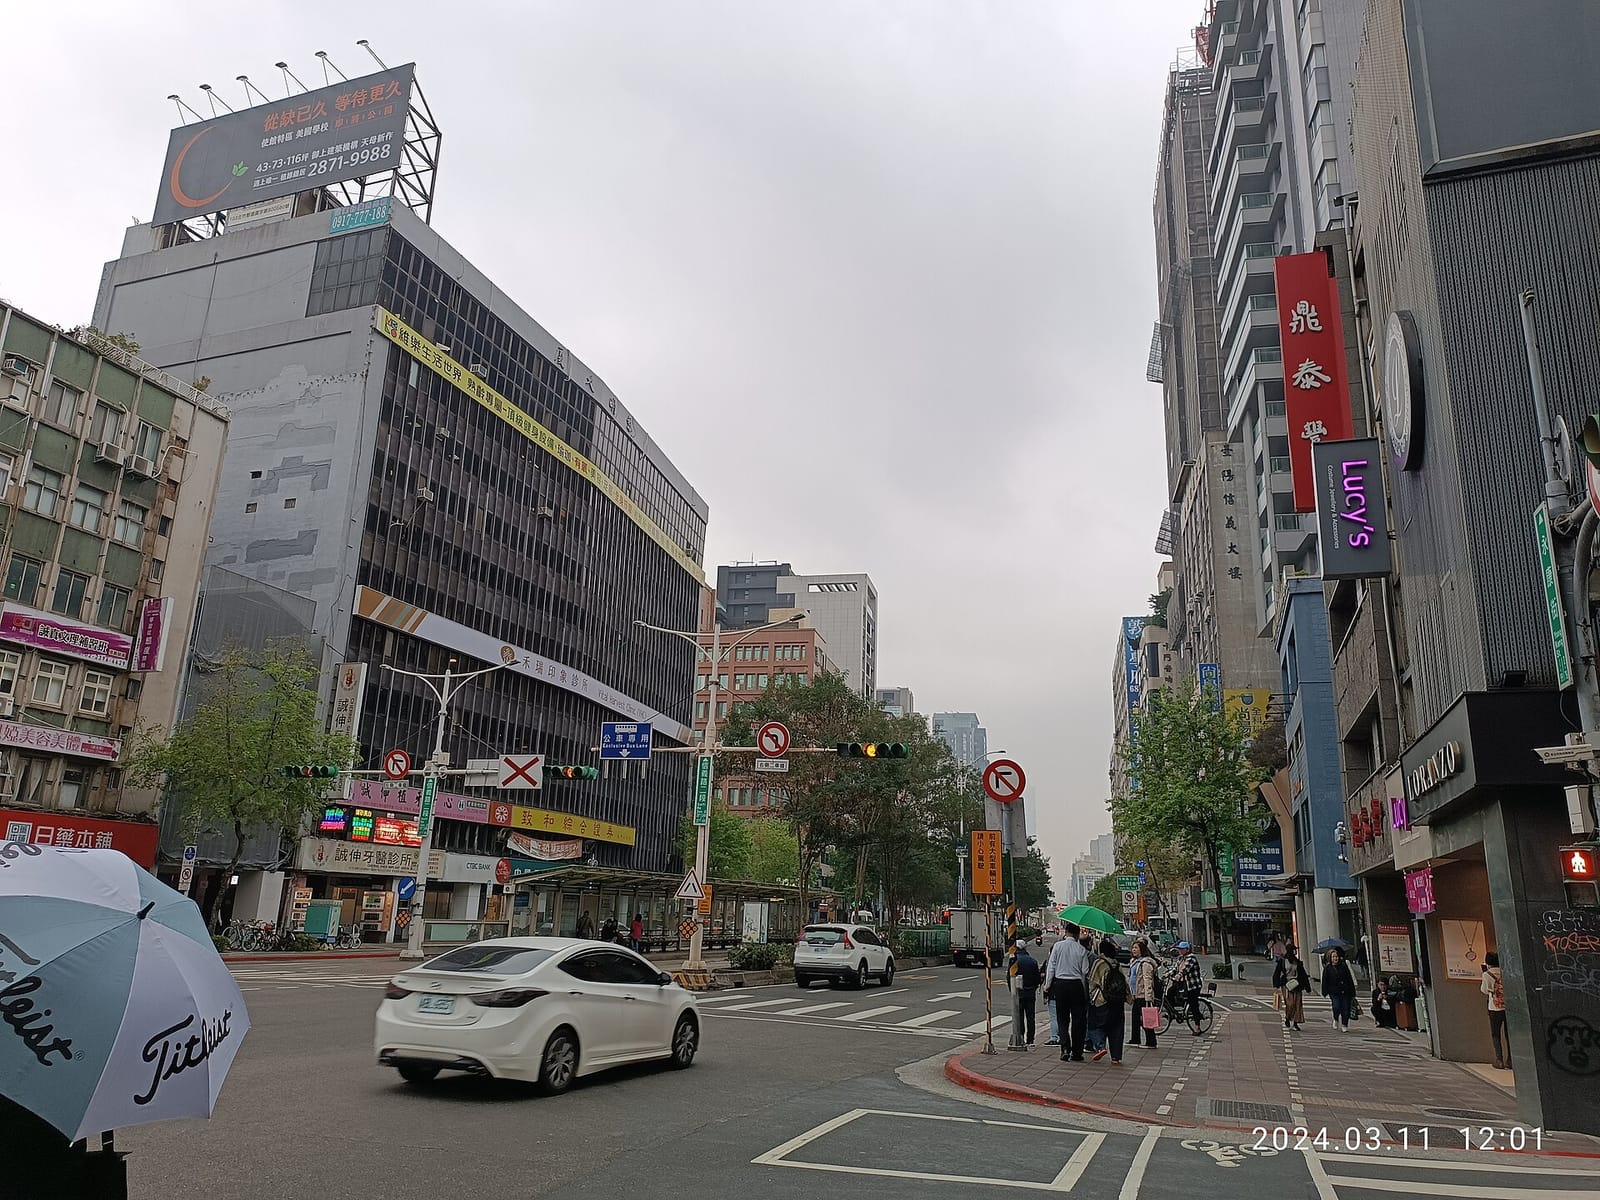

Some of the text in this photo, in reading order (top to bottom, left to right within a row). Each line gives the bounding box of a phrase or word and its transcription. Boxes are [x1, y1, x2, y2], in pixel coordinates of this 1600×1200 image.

[264, 80, 402, 132] 從缺已久 等待更久
[296, 122, 329, 138] 美國學校
[361, 132, 394, 148] 天母新作
[308, 144, 391, 177] 2871-9988
[1340, 460, 1375, 547] Lucy's
[603, 734, 649, 743] 公車專用
[1407, 741, 1455, 801] LORANZO
[335, 847, 411, 867] 誠伸牙醫診所
[133, 1009, 231, 1105] Titleist
